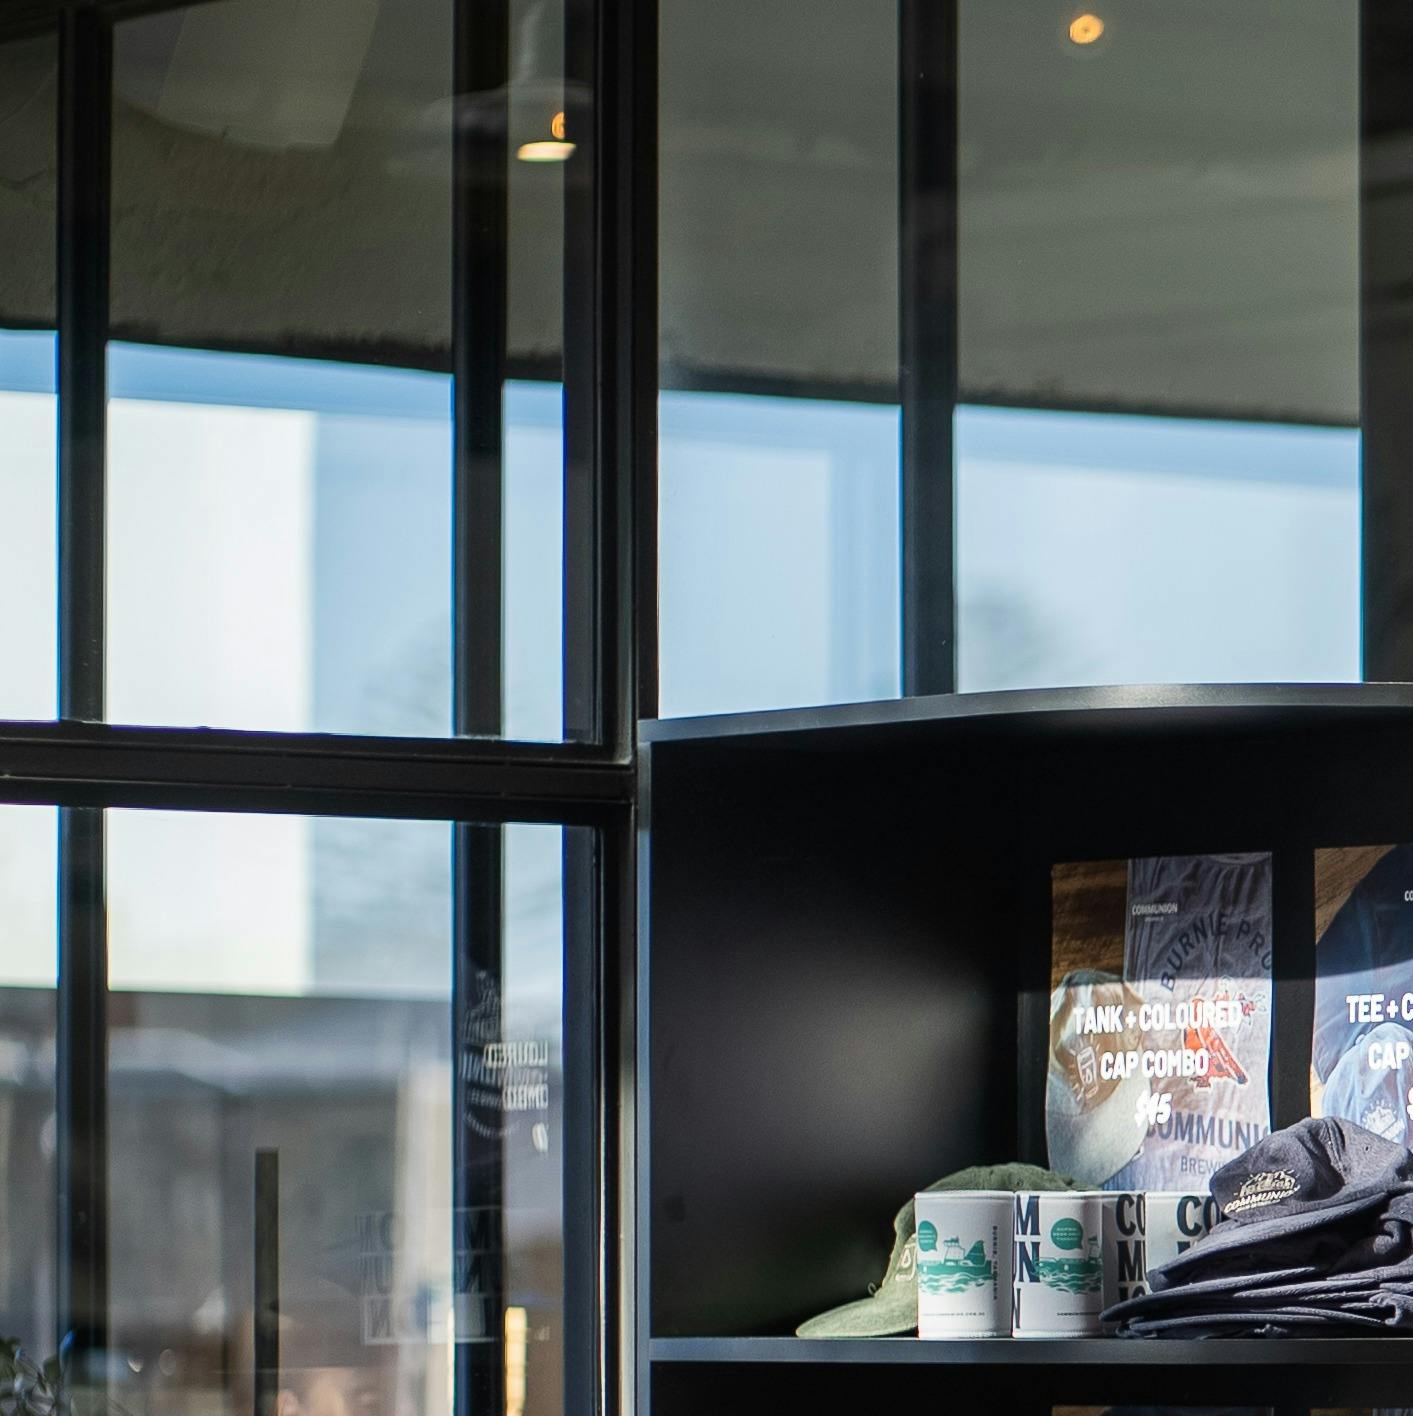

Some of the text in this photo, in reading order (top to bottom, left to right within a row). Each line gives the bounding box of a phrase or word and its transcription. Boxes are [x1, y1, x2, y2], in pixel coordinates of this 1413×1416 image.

[1131, 902, 1178, 916] COMMUNION
[1160, 909, 1228, 993] BURNIE
[1073, 1001, 1243, 1034] TANK + COLOURED
[1346, 993, 1384, 1023] TEE
[1386, 1003, 1399, 1018] +
[1099, 1049, 1210, 1080] CAP COMBO
[1368, 1041, 1409, 1070] CAP
